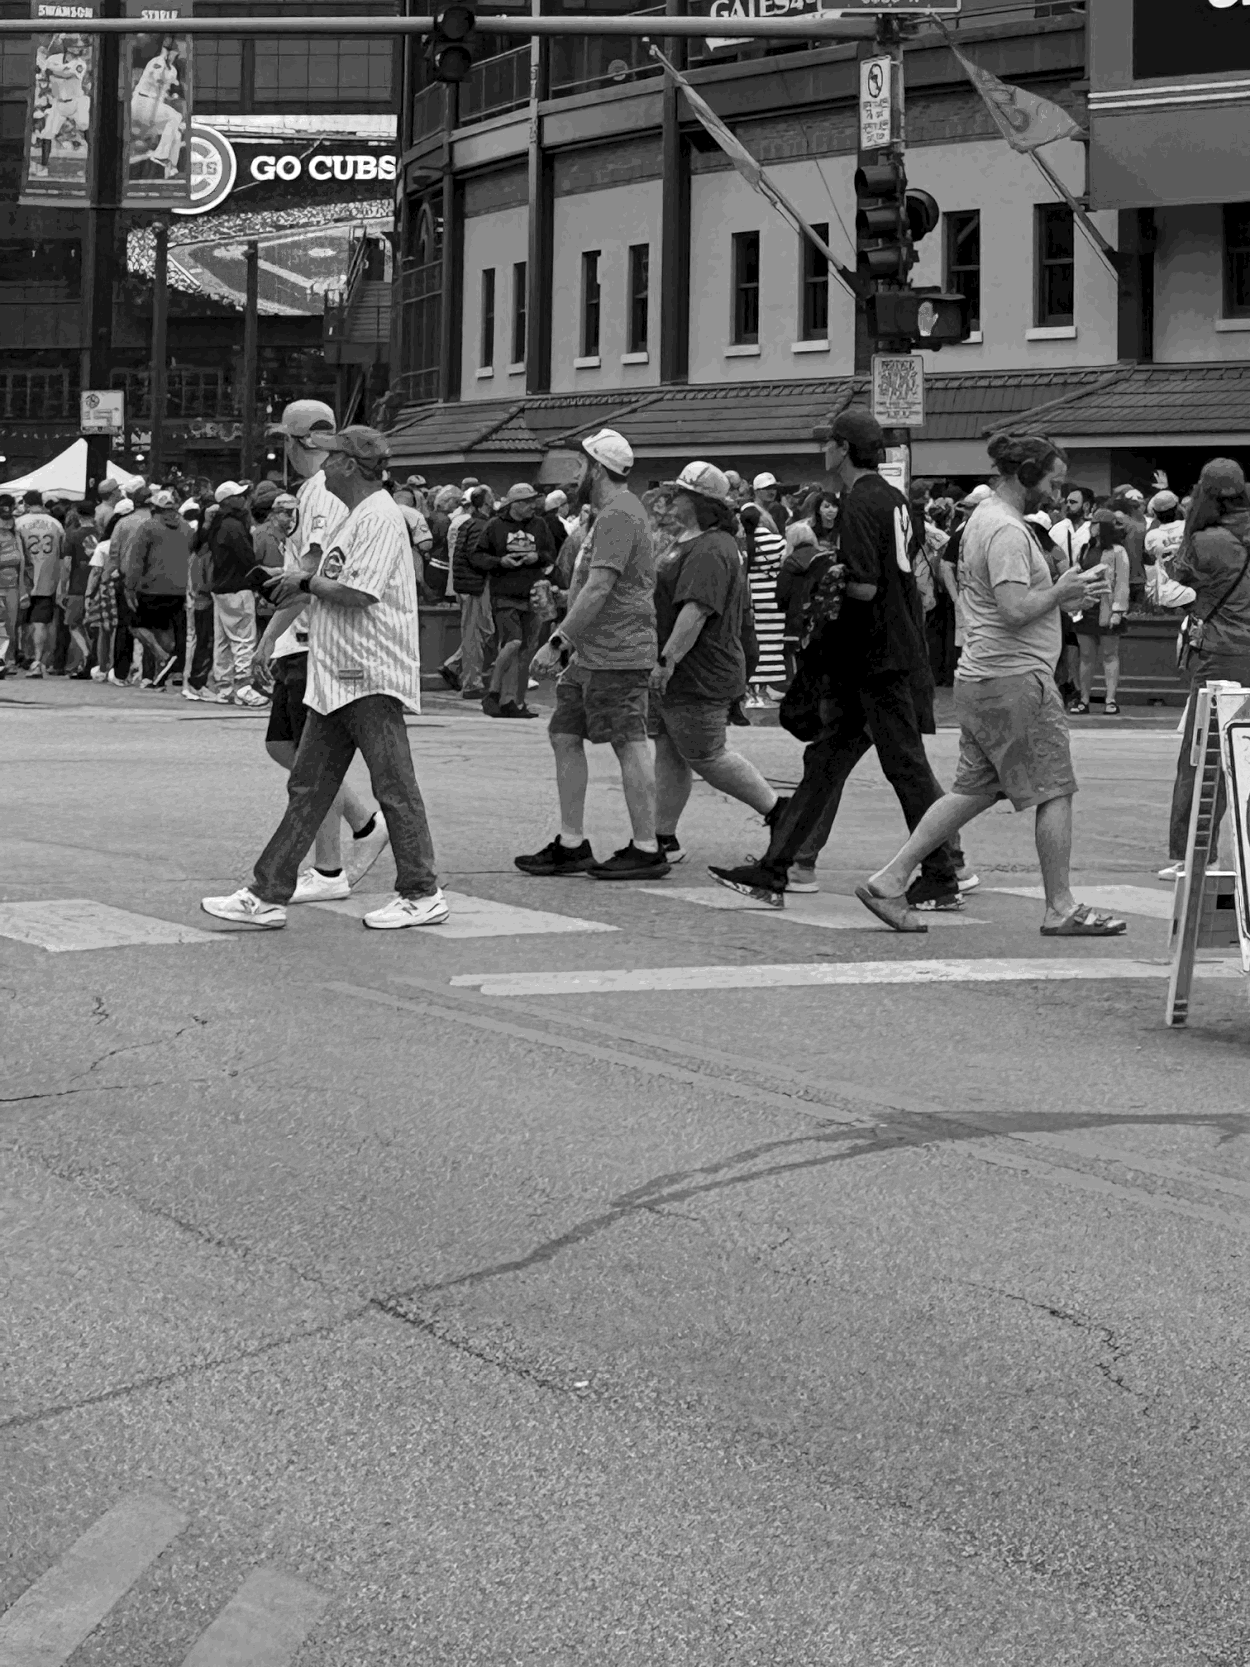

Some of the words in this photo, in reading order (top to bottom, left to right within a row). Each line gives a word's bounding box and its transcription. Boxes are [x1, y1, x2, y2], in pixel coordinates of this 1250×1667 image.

[250, 155, 302, 181] GO
[308, 154, 397, 181] CUBS
[27, 534, 53, 555] 23
